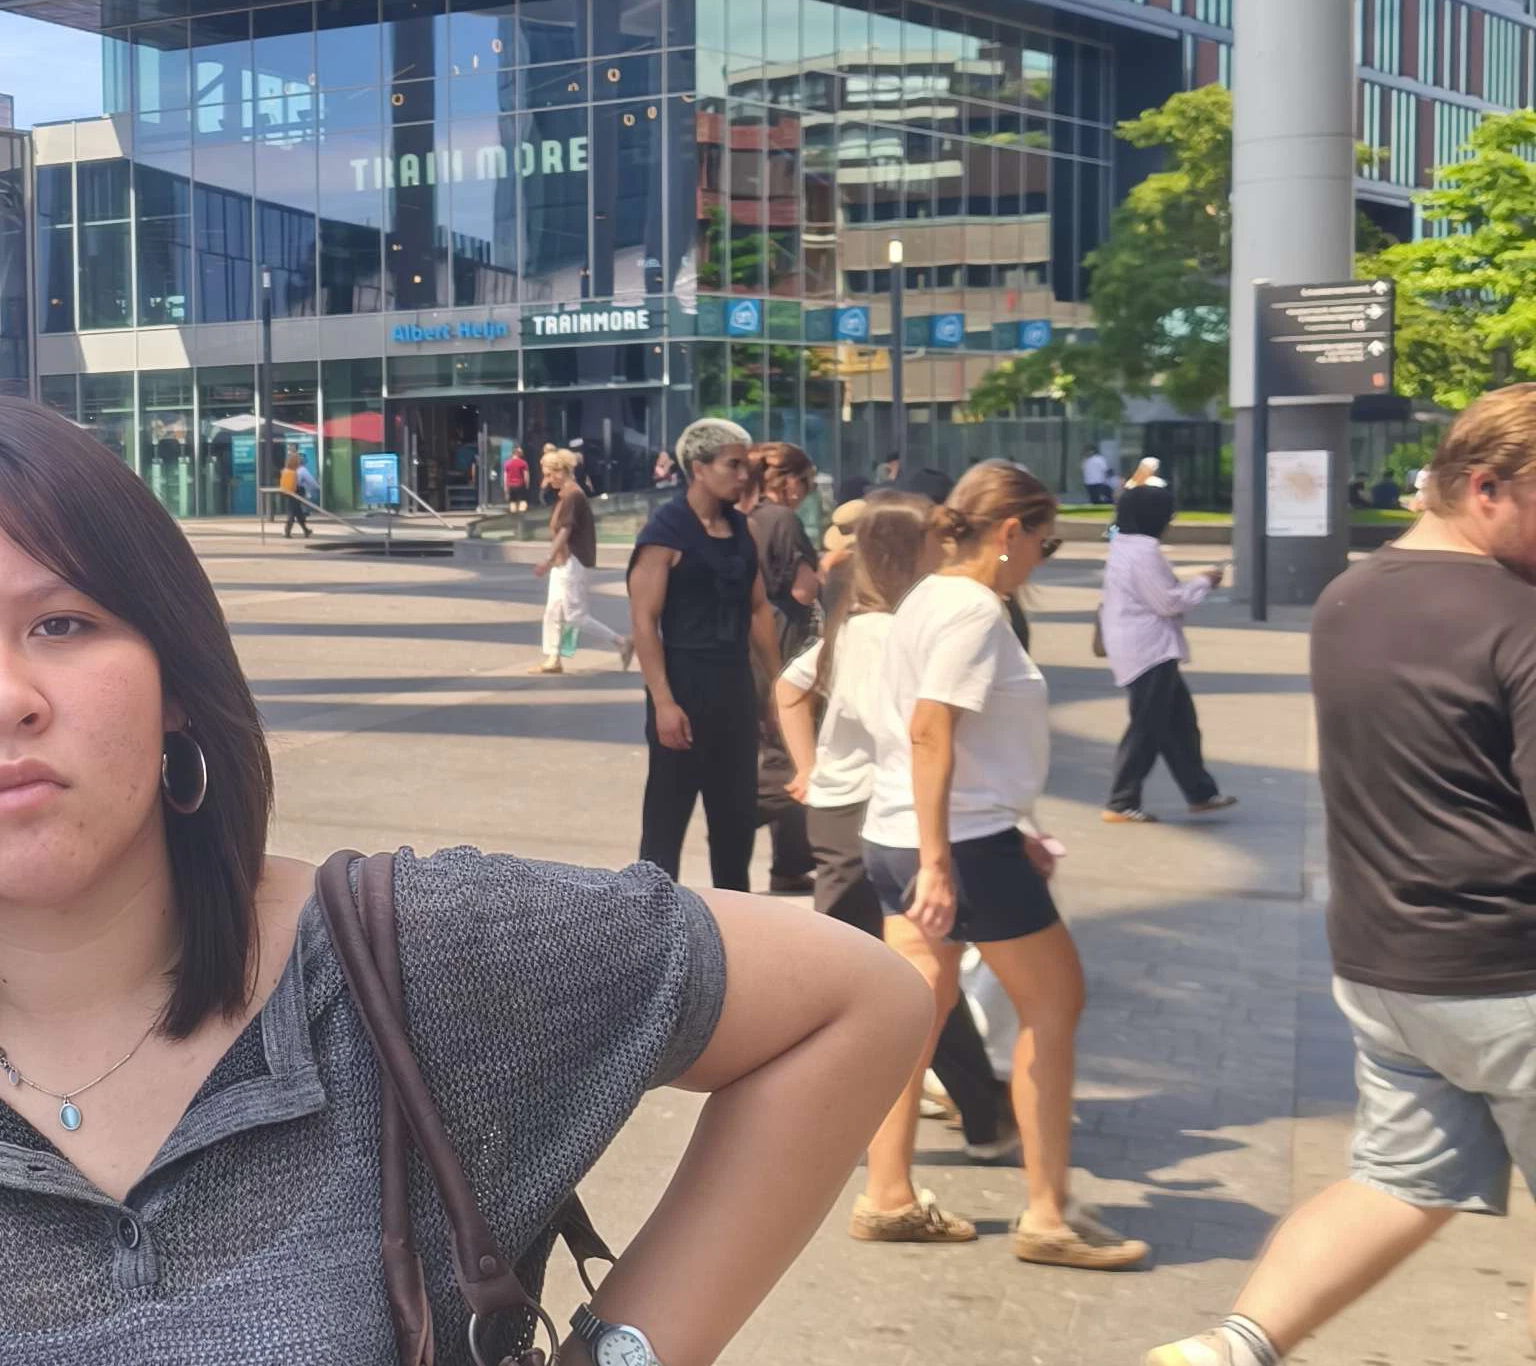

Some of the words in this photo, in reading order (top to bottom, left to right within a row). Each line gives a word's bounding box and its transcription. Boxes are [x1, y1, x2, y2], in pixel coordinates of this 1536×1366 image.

[392, 323, 449, 342] Albert
[459, 320, 508, 342] Heijn
[532, 309, 650, 335] TRAINMORE
